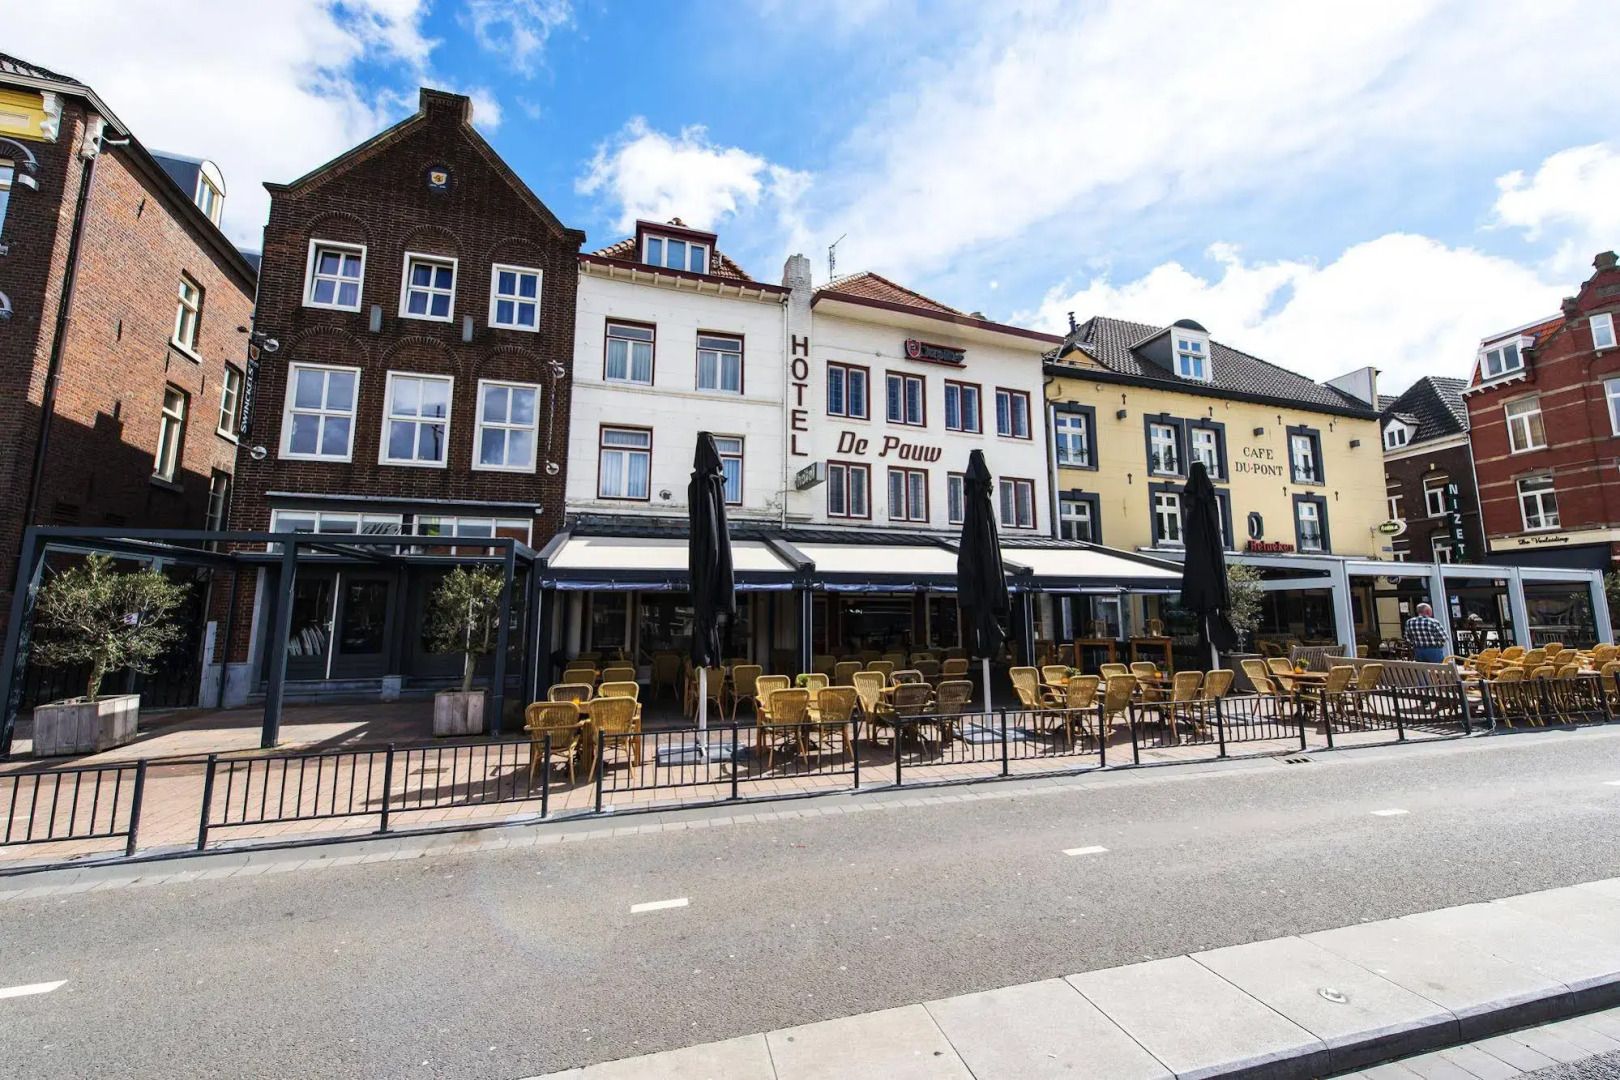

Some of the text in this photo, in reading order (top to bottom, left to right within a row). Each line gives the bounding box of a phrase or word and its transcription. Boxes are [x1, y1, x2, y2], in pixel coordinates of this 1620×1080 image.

[791, 334, 808, 455] HOTEL
[837, 431, 942, 462] De Pauw
[1448, 483, 1465, 555] NIZET
[1250, 541, 1295, 553] Heineken
